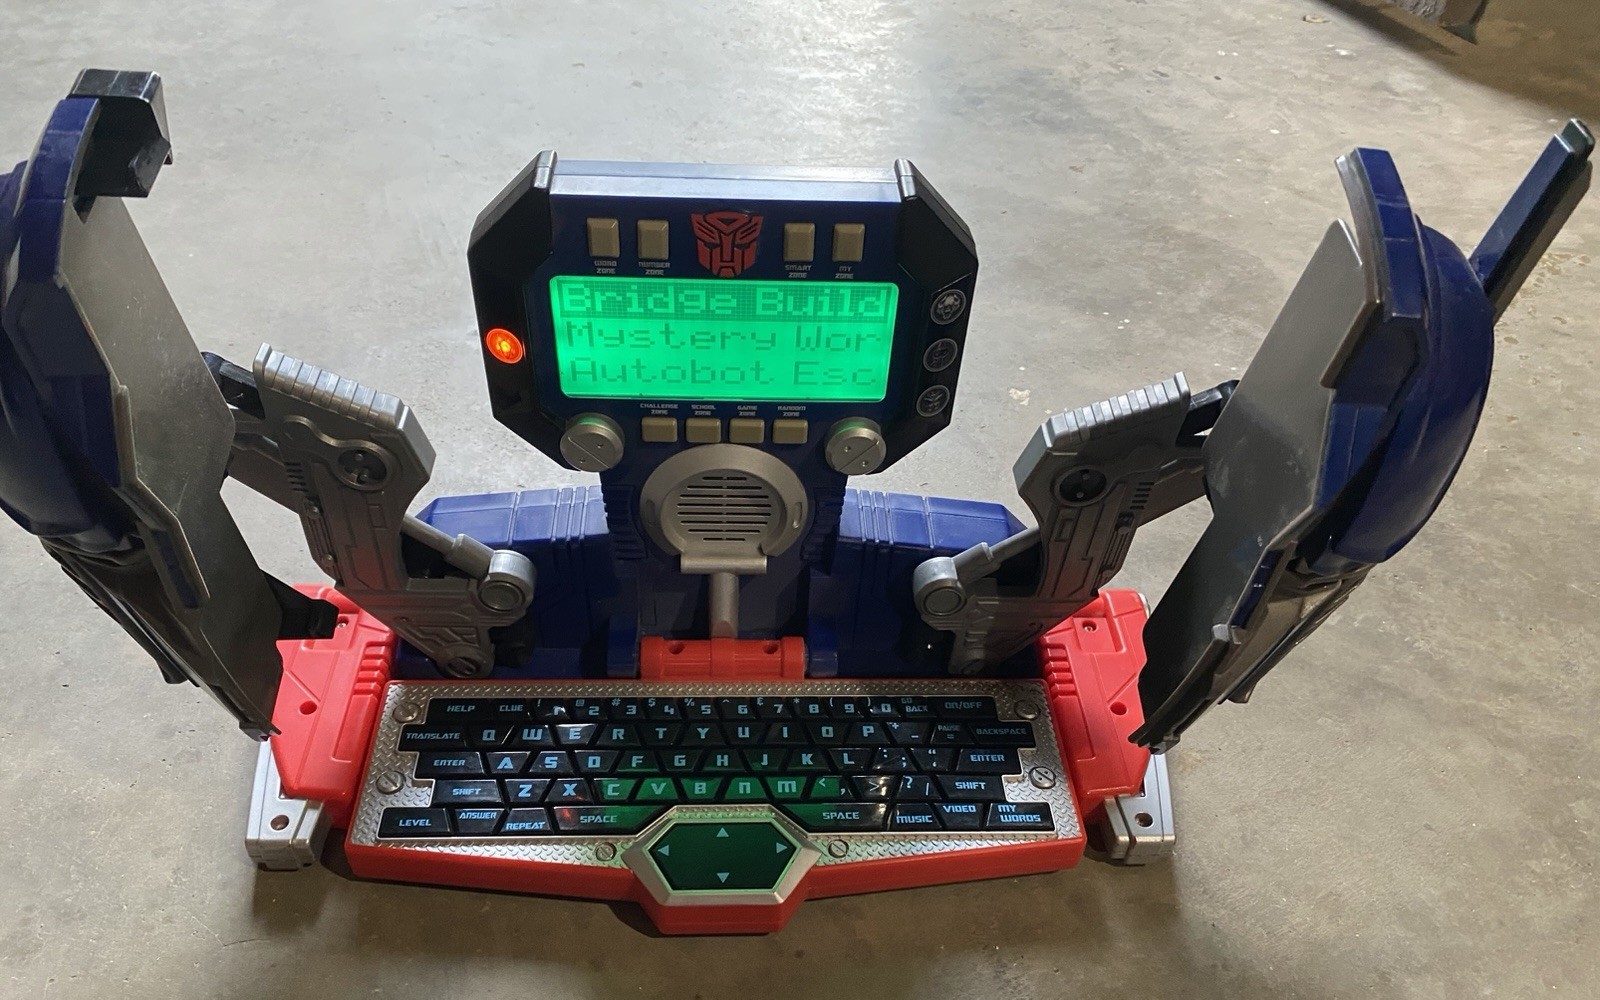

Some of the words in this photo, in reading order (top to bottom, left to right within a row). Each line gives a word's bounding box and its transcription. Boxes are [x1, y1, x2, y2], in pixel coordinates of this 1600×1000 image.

[596, 267, 616, 275] ZONE
[785, 264, 812, 272] SMART
[561, 283, 737, 315] Bridge
[755, 286, 888, 317] Build
[566, 321, 776, 351] Mystery
[795, 325, 882, 352] Wor
[570, 357, 775, 385] Autobot
[793, 361, 877, 386] Esc
[640, 402, 679, 410] CHALLENGE
[691, 403, 716, 411] SCHOOL
[446, 704, 476, 713] HELP
[499, 704, 524, 713] CLUE
[588, 705, 600, 716] 2
[626, 705, 637, 715] 3
[663, 704, 675, 715] 4
[701, 704, 712, 715] 5
[737, 704, 749, 715] 6
[773, 703, 784, 714] 7
[808, 703, 820, 714] 8
[844, 703, 855, 714] 9
[905, 705, 929, 713] BACK
[944, 701, 983, 710] ON/OFF
[406, 732, 461, 740] TRANSLATE
[522, 728, 543, 741] W
[568, 727, 582, 740] E
[612, 728, 625, 740] R
[655, 727, 668, 739] T
[696, 727, 710, 739] Y
[737, 726, 750, 738] U
[862, 725, 875, 737] P
[433, 759, 466, 767] ENTER
[497, 757, 514, 769] A
[544, 756, 559, 769] S
[587, 756, 601, 768] D
[631, 755, 644, 768] F
[673, 755, 686, 767] G
[716, 754, 729, 767] H
[761, 753, 769, 766] J
[801, 753, 814, 765] K
[843, 752, 855, 765] L
[969, 754, 1006, 762] ENTER
[517, 784, 533, 798] Z
[562, 783, 578, 796] X
[607, 783, 620, 796] C
[651, 782, 667, 795] V
[694, 782, 707, 795] B
[954, 781, 987, 790] SHIFT
[452, 788, 482, 796] SHIFT
[942, 805, 977, 813] VIDEO
[997, 804, 1017, 813] MY
[458, 811, 497, 820] ANSWER
[579, 815, 618, 824] SPACE
[822, 811, 860, 820] SPACE
[895, 815, 933, 824] MUSIC
[1000, 814, 1041, 823] WORDS
[398, 819, 432, 827] LEVEL
[505, 821, 546, 831] REPEAT
